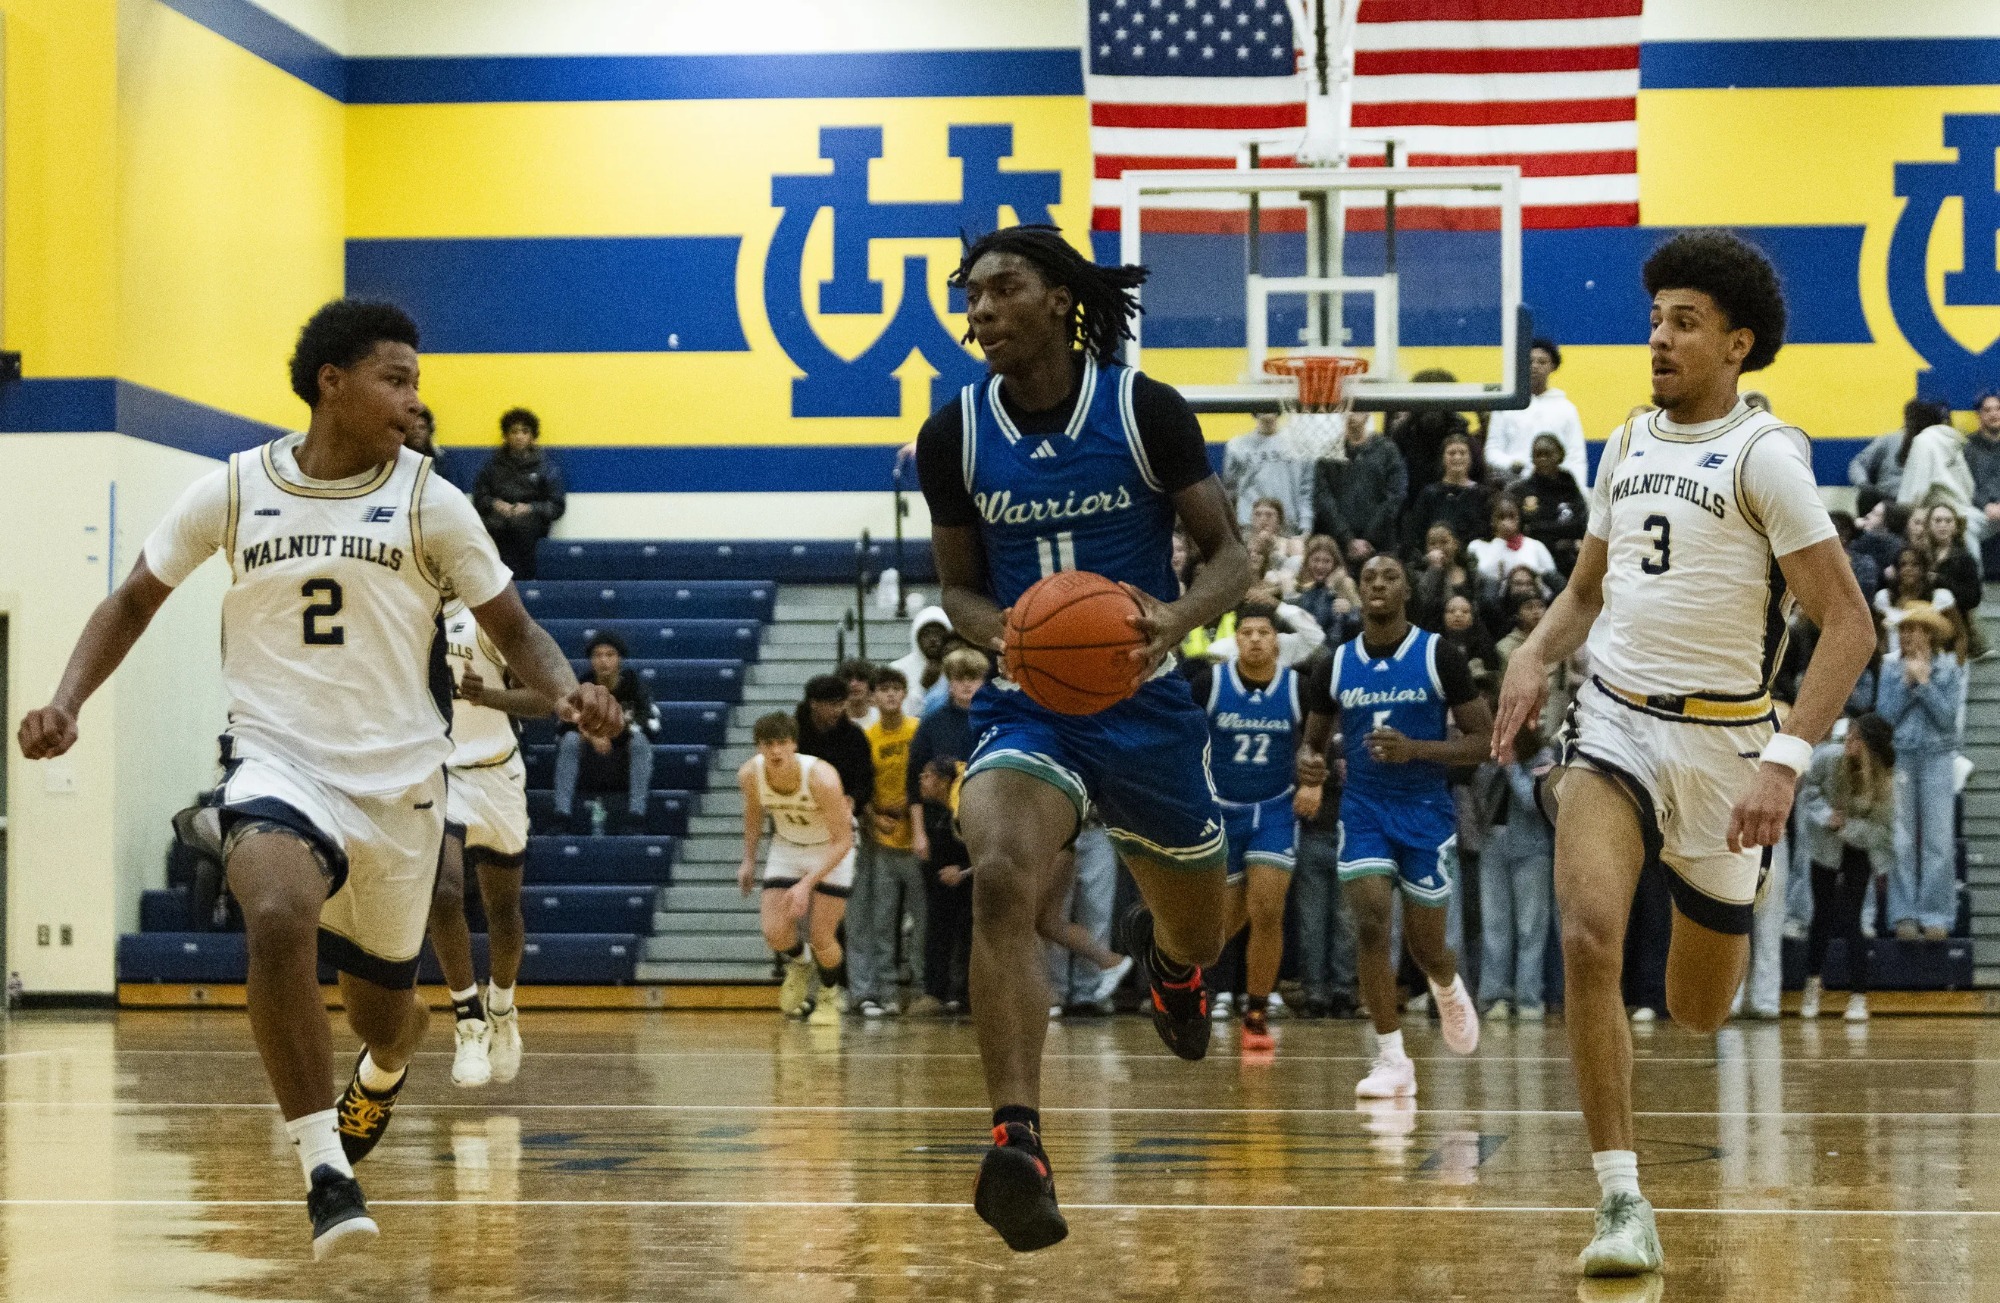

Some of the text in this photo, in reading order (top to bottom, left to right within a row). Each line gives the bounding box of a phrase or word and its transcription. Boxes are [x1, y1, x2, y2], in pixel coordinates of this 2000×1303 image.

[974, 484, 1133, 526] Warriors
[1611, 473, 1726, 519] WALNUT HILLS
[242, 534, 404, 573] WALNUT HILLS
[1036, 531, 1077, 579] 11
[1640, 514, 1671, 576] 3
[300, 577, 346, 646] 2
[446, 642, 474, 660] ILLS
[1339, 687, 1428, 708] Warriors
[1216, 711, 1291, 731] Warriors
[1233, 733, 1271, 765] 22
